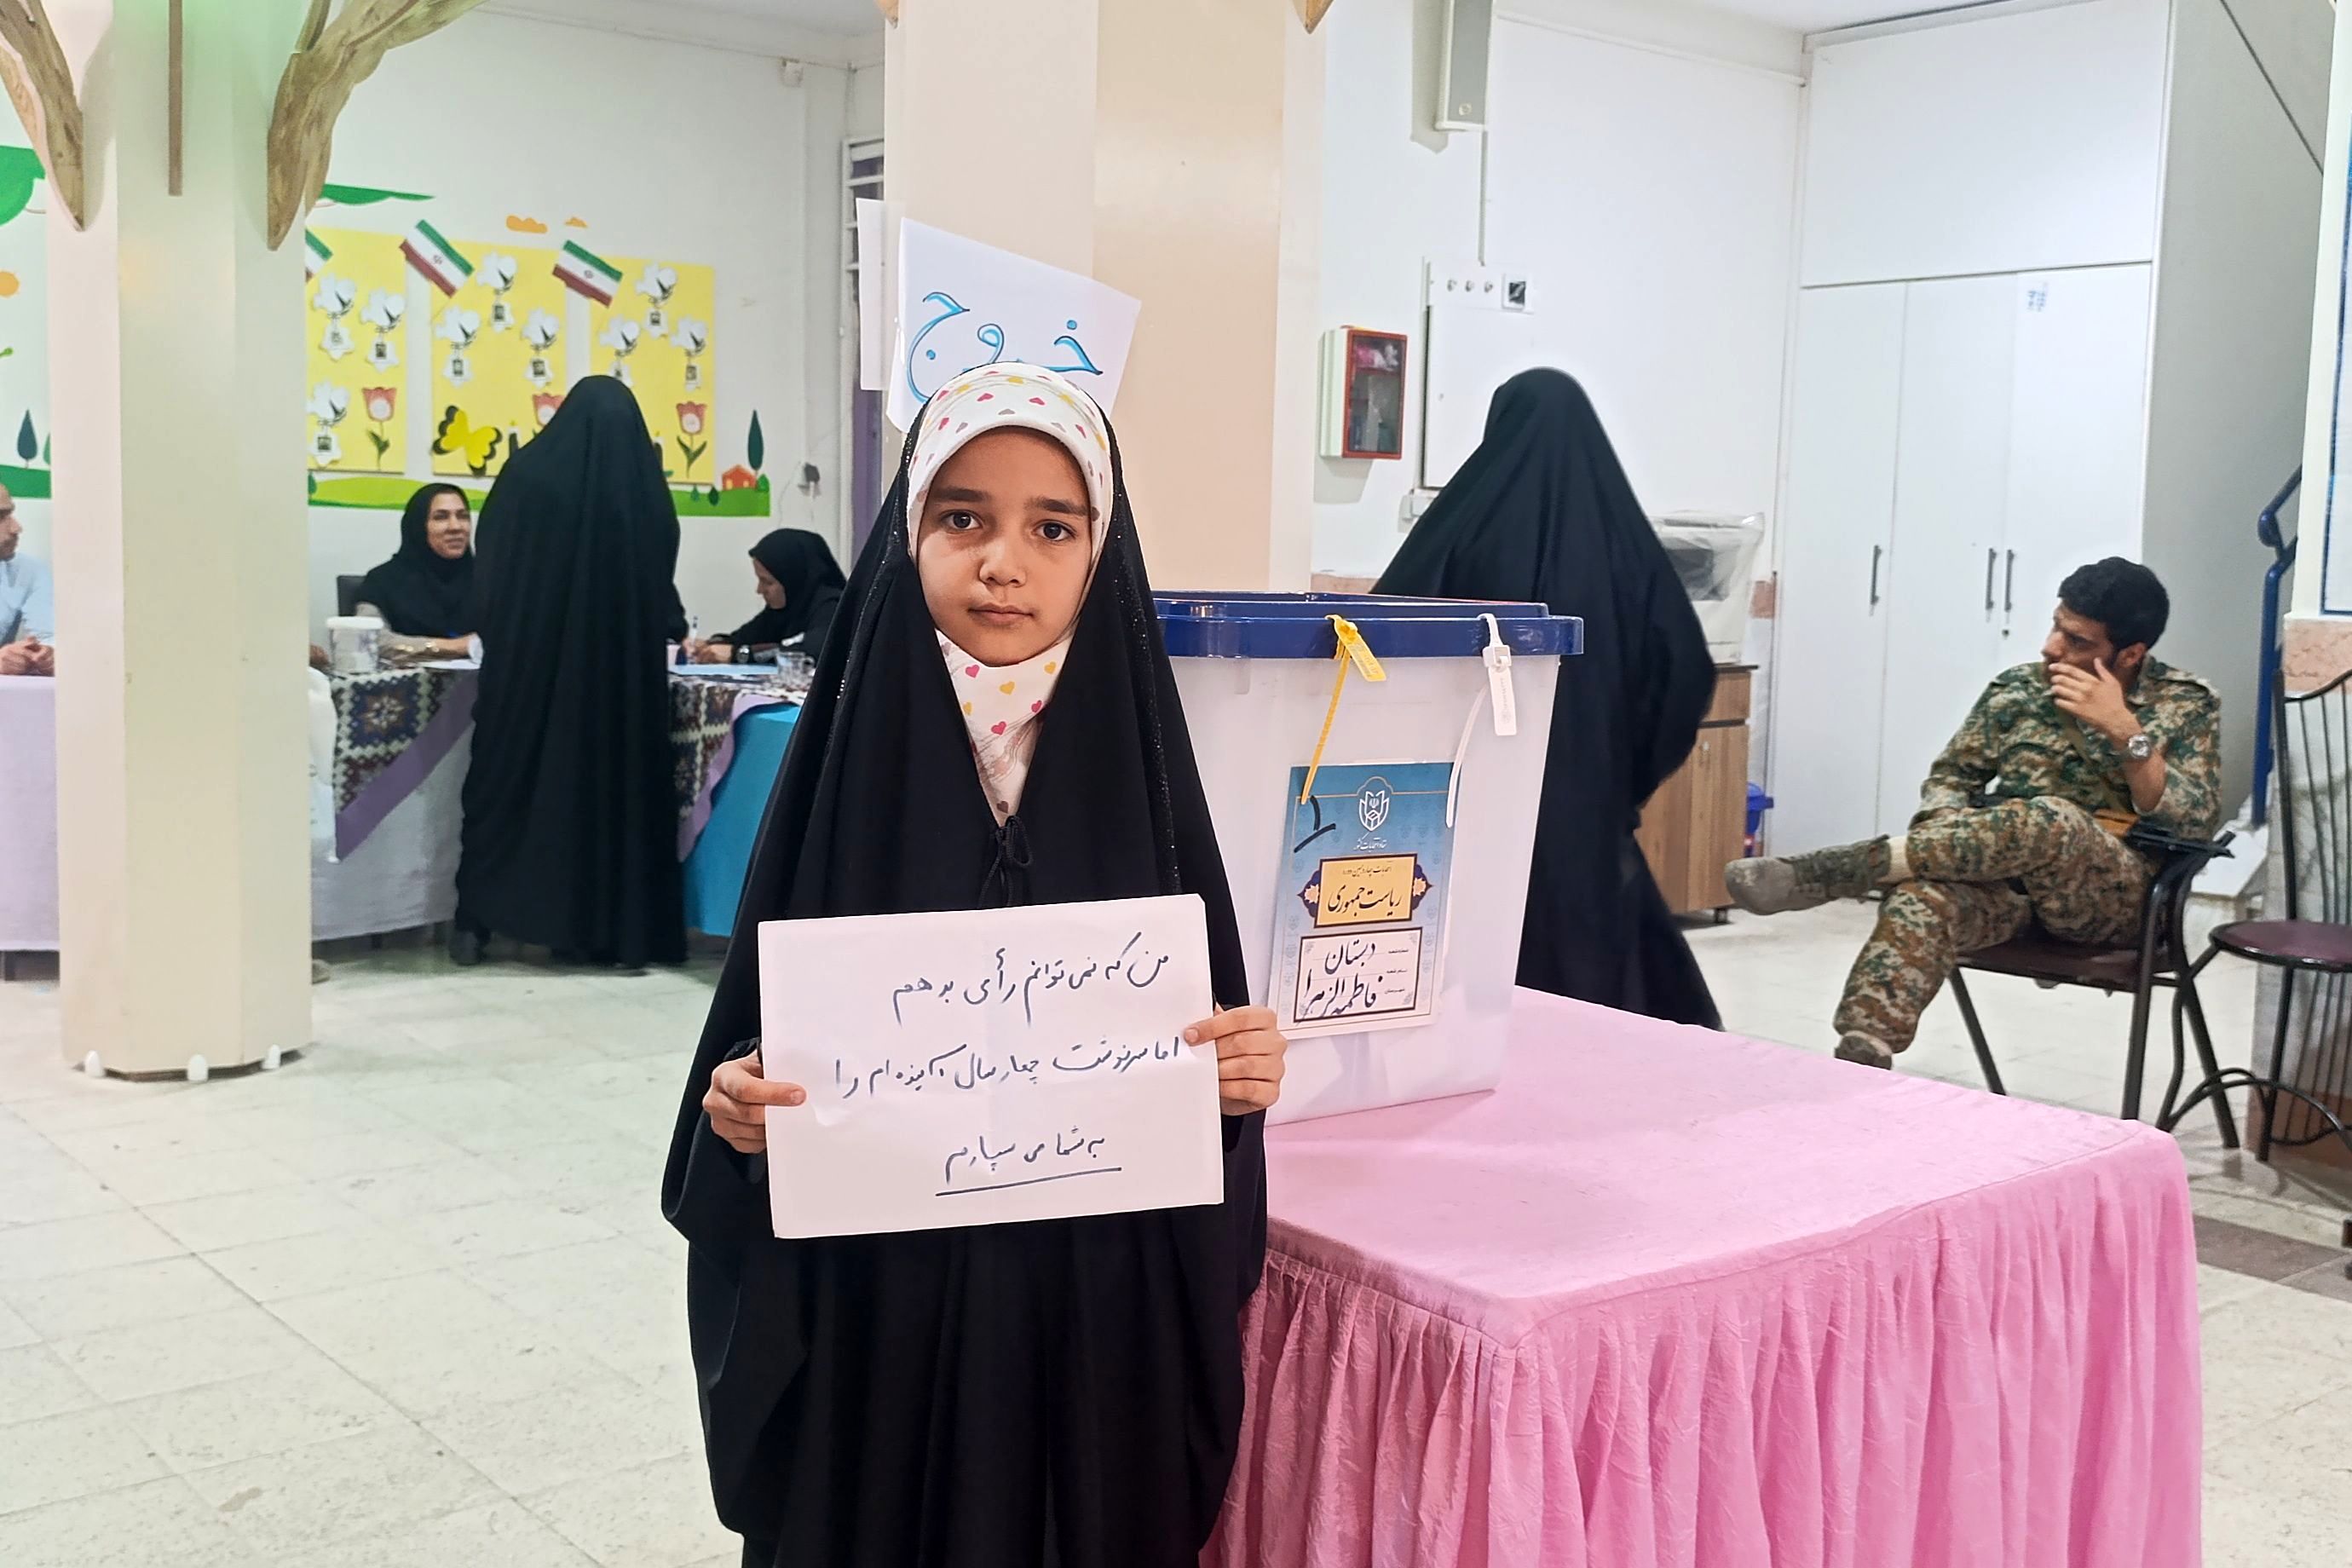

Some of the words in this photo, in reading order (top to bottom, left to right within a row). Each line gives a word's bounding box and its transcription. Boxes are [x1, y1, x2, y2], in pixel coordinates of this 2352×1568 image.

[906, 291, 1104, 404] خوج
[1328, 884, 1365, 917] جمهوری
[1358, 887, 1403, 917] ریاست
[1105, 931, 1142, 980] که
[1127, 950, 1169, 989] من
[1324, 938, 1376, 975] دبستان
[1052, 1035, 1150, 1073] سرنوشت
[1155, 1035, 1180, 1060] اما
[834, 1058, 859, 1099] را
[1056, 1125, 1086, 1156] شما
[1087, 1138, 1105, 1159] به
